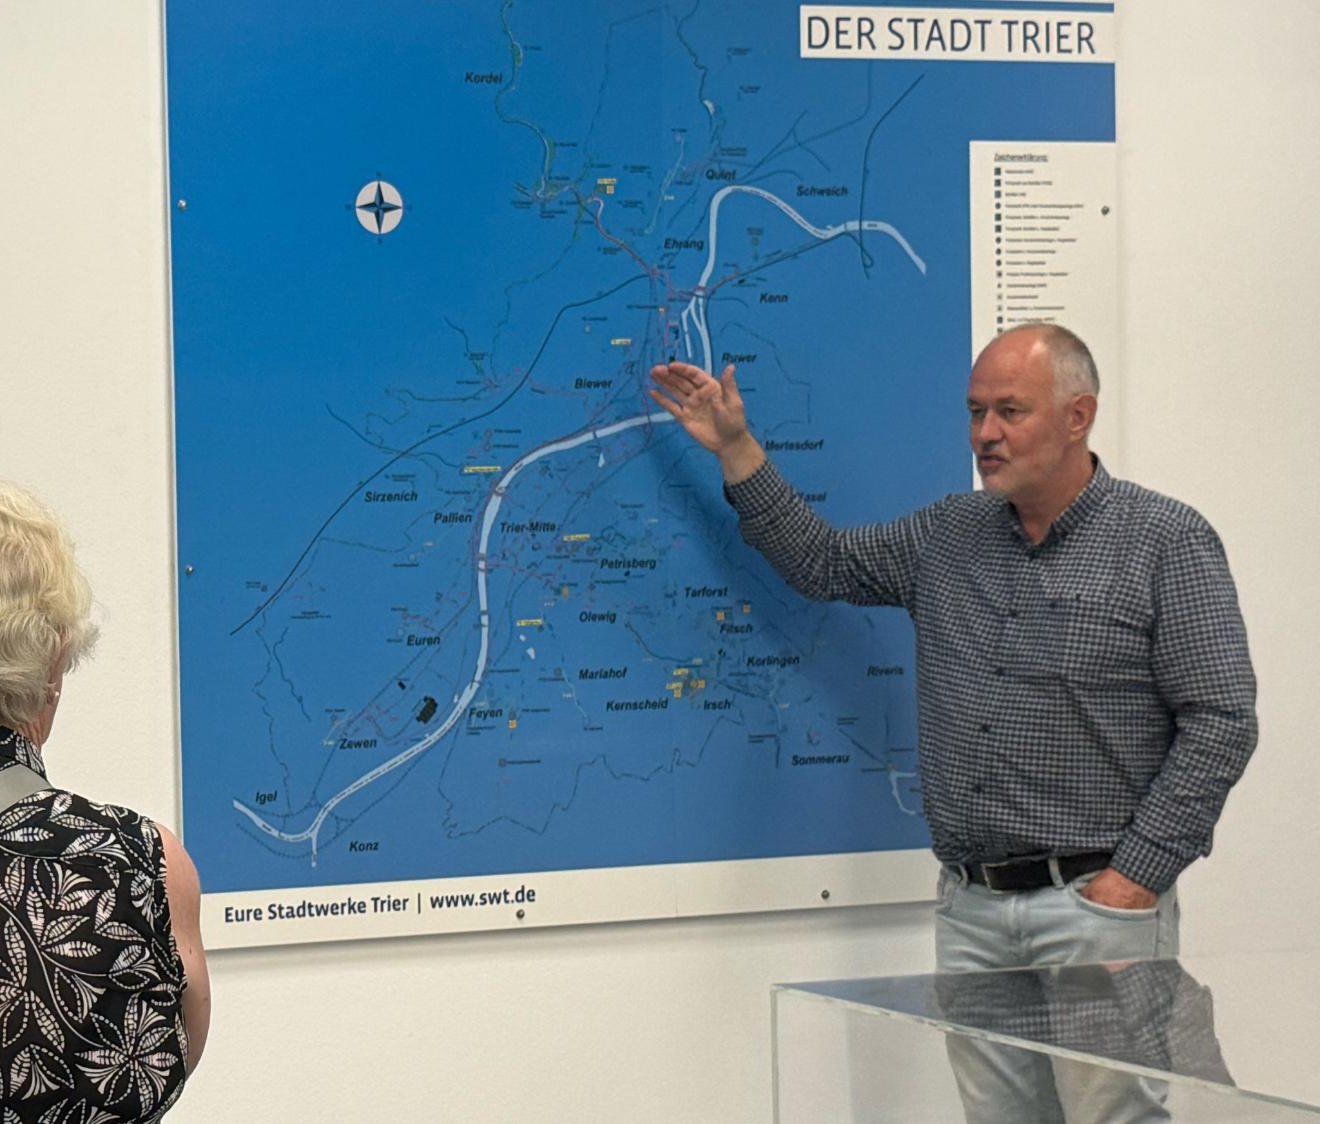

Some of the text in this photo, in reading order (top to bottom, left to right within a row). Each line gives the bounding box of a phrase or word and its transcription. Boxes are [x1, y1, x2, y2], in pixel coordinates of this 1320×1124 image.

[807, 16, 1096, 54] DER STADT TRIER
[465, 71, 503, 85] Kordel
[705, 168, 736, 181] Quint
[796, 184, 848, 197] Schweich
[664, 238, 704, 251] Ehrang
[760, 292, 788, 304] Kenn
[722, 352, 756, 364] Ruwer
[574, 377, 612, 389] Biewer
[364, 490, 418, 503] Sirzenich
[434, 511, 472, 524] Pallien
[501, 521, 556, 534] Trier-Mitte
[600, 557, 656, 571] Petrisberg
[684, 586, 728, 598] Tarforst
[579, 610, 617, 624] Olewig
[407, 635, 440, 646] Euren
[746, 654, 800, 667] Korlingen
[579, 667, 627, 680] Mariahof
[867, 665, 904, 677] Riveris
[606, 698, 668, 712] Kernscheid
[704, 699, 731, 711] Irsch
[468, 707, 503, 720] Feyen
[339, 737, 377, 750] Zewen
[792, 754, 849, 766] Sommerau
[255, 790, 277, 804] Igel
[349, 840, 379, 853] Konz
[224, 885, 536, 923] Eure Stadtwerke Trier www.swt.de
